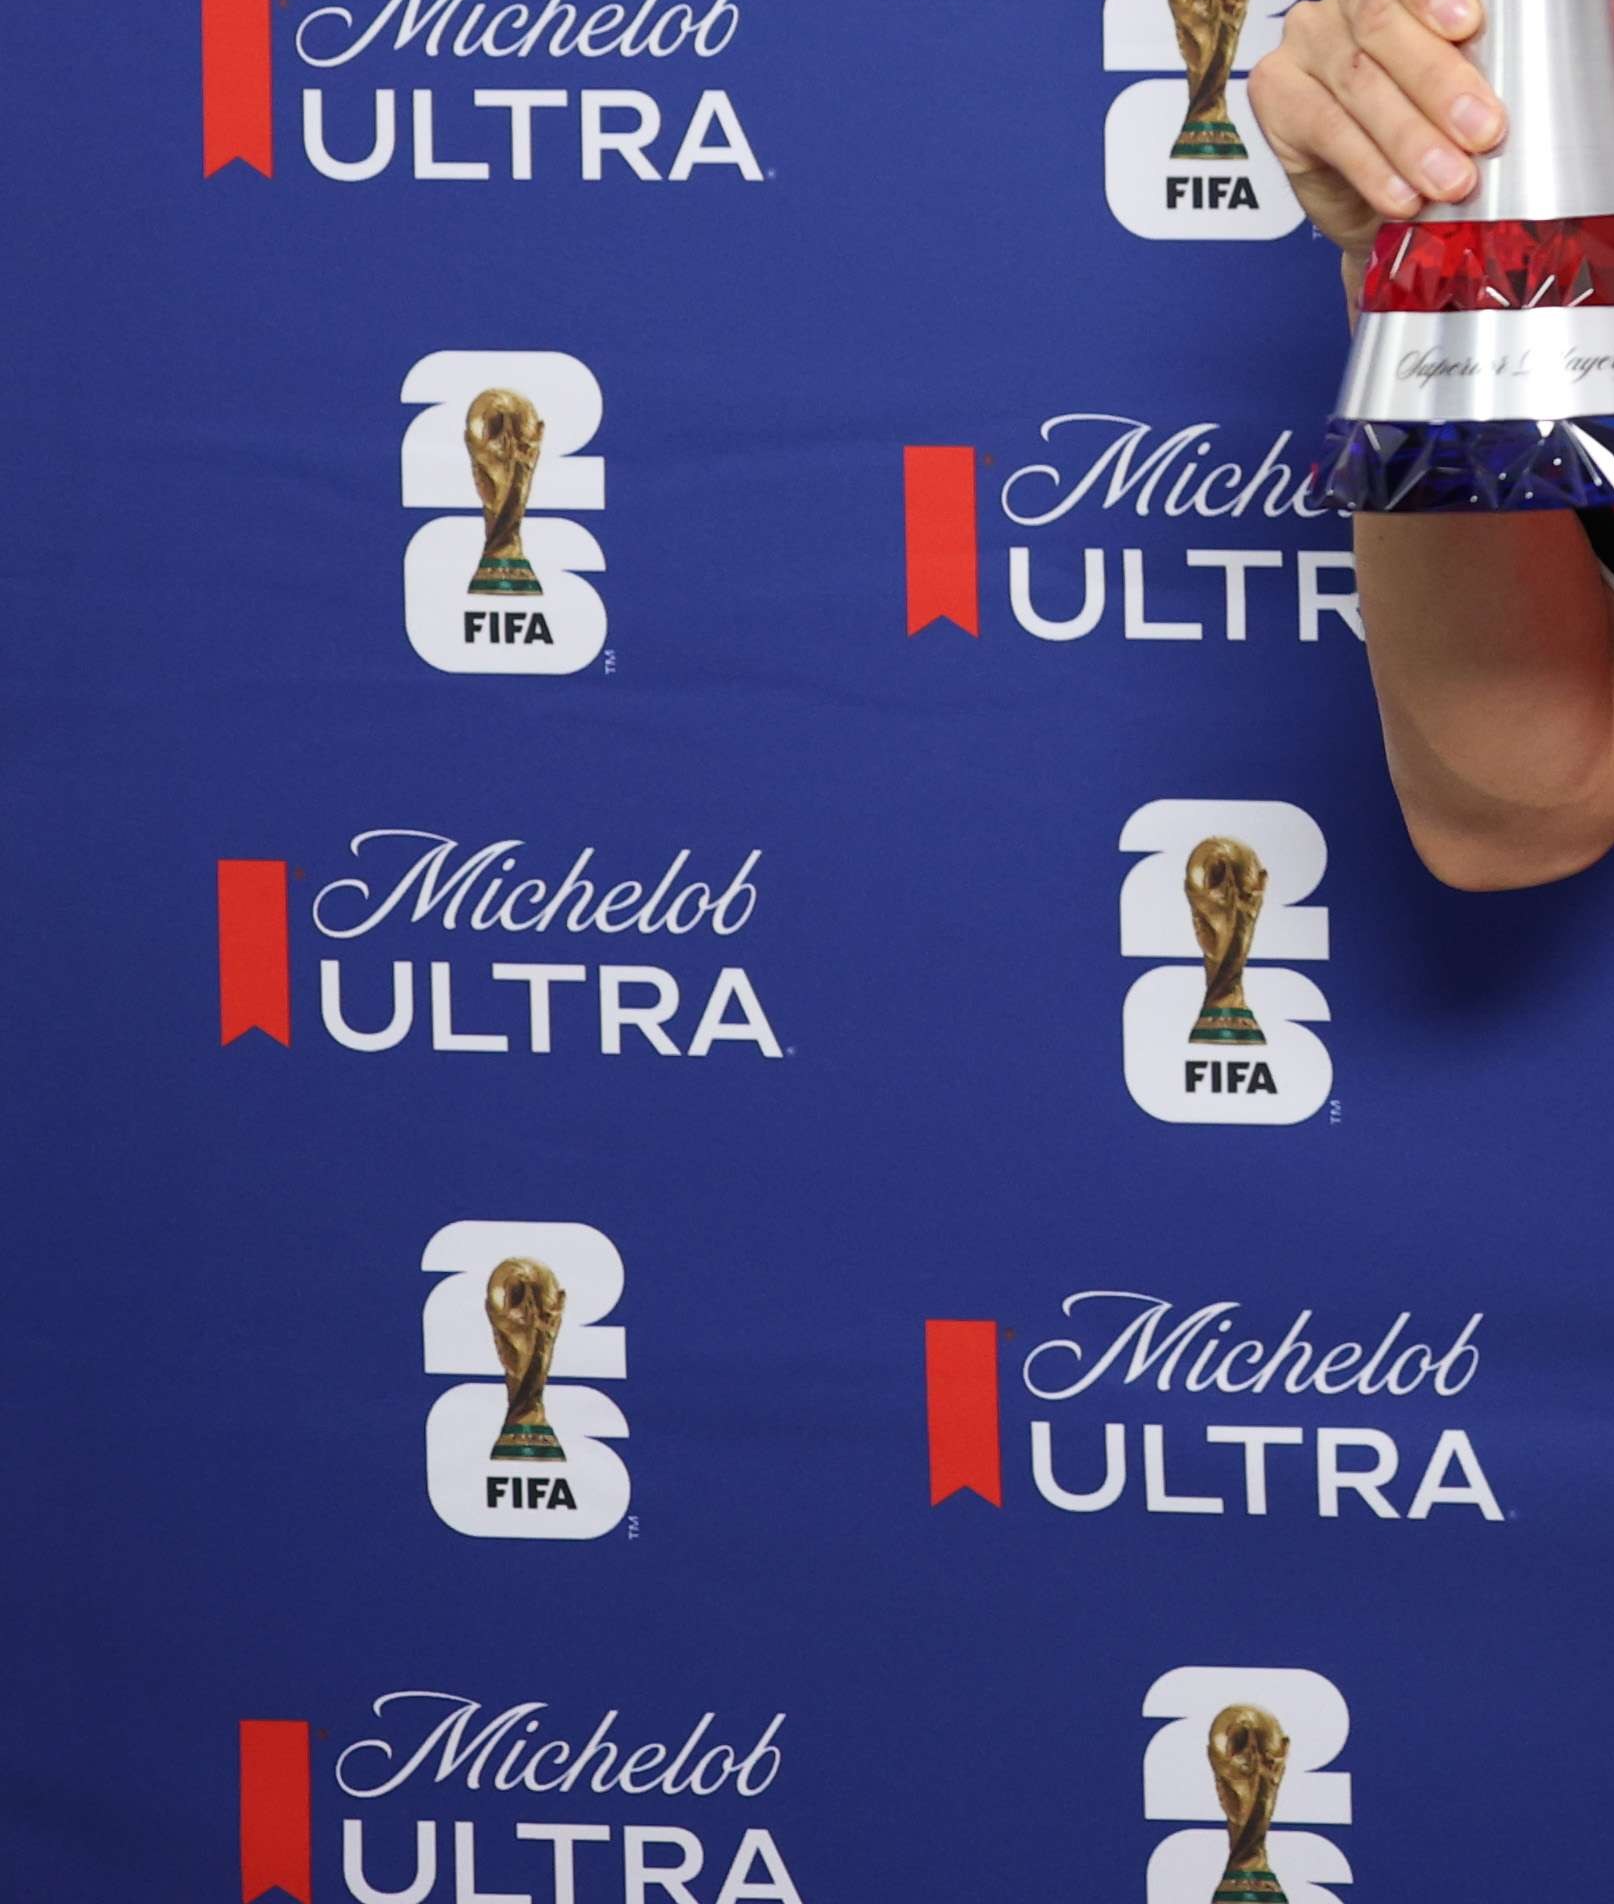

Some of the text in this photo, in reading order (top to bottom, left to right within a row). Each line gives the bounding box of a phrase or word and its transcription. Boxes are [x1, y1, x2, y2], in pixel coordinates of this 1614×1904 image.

[303, 89, 764, 181] ULTRA
[1165, 176, 1261, 211] FIFA
[464, 611, 554, 645] FIFA
[1009, 546, 1365, 641] ULTR
[313, 830, 762, 938] Michelob
[321, 960, 783, 1057] ULTRA
[1185, 1060, 1278, 1095] FIFA
[1023, 1291, 1483, 1399] Michelob
[486, 1476, 577, 1510] FIFA
[1031, 1421, 1504, 1520] ULTRA
[336, 1691, 786, 1797] Michelob
[344, 1819, 802, 1904] ULTRA
